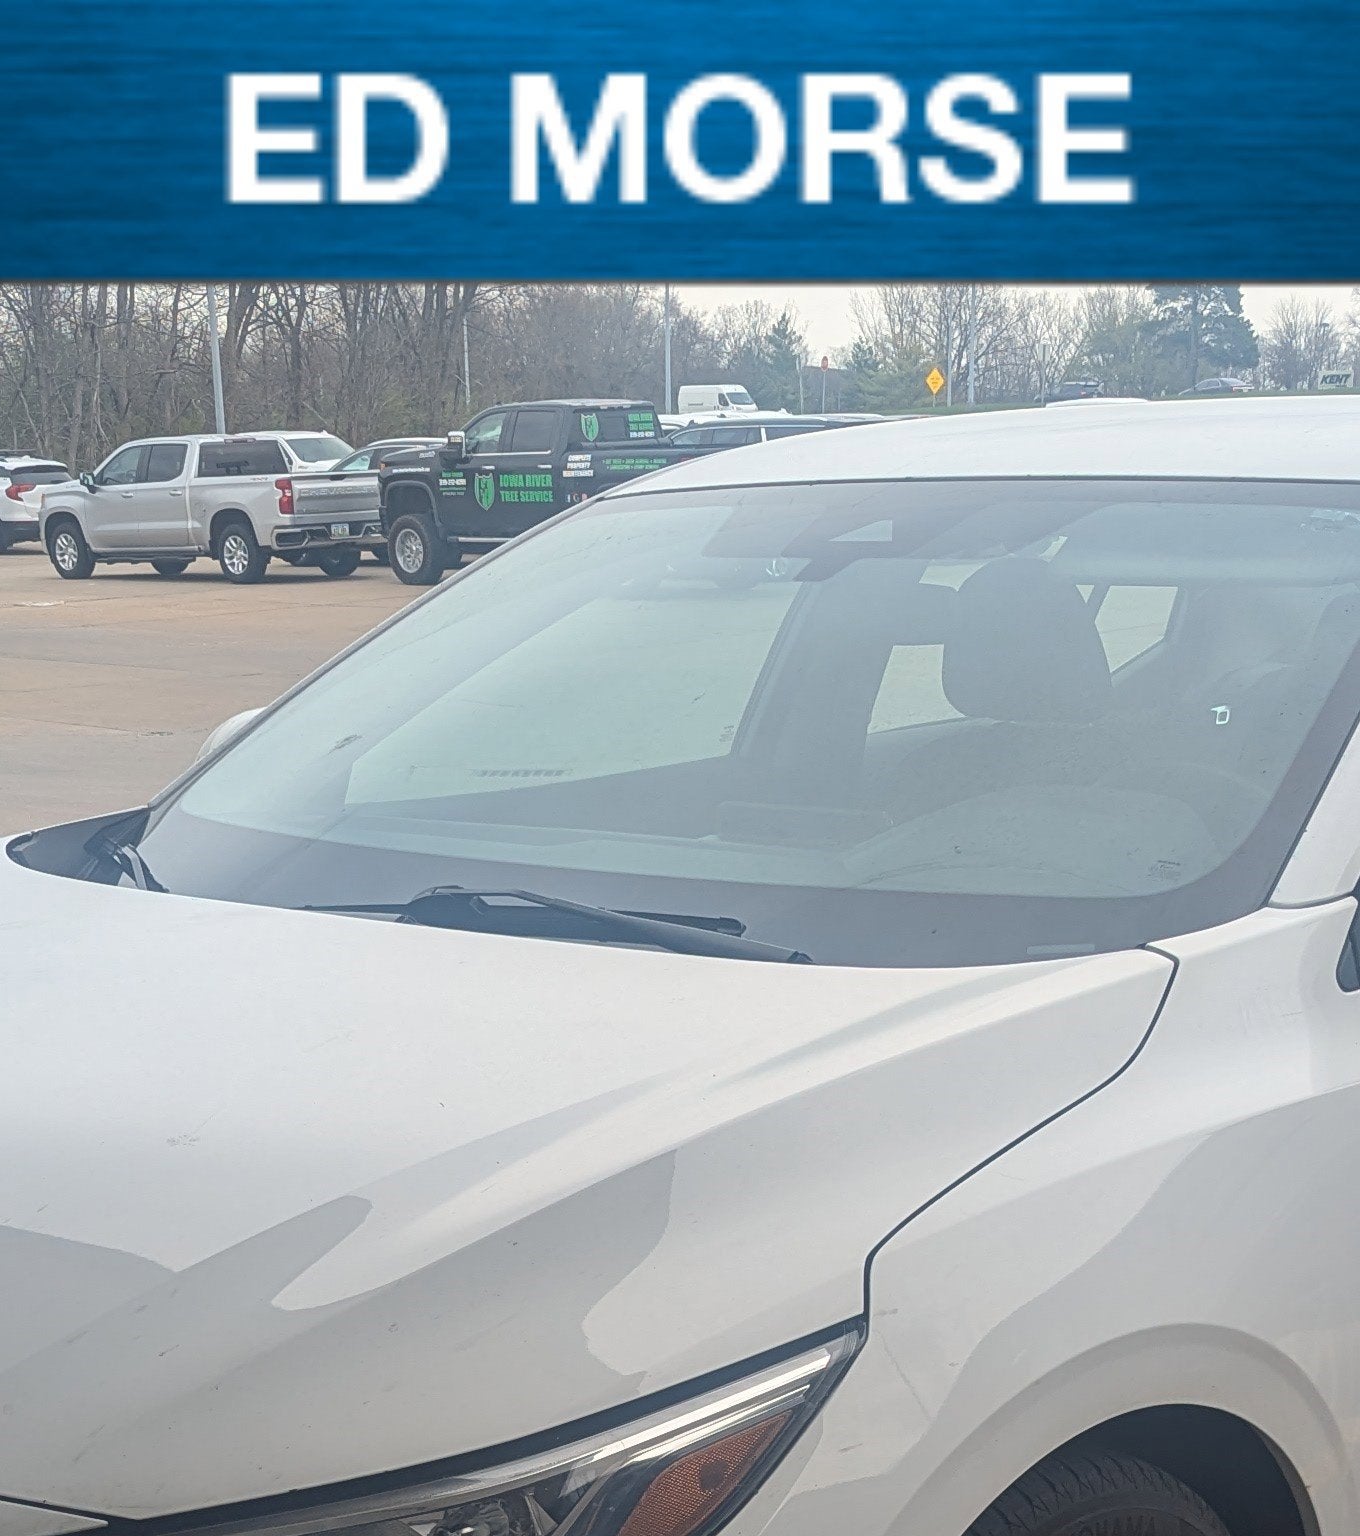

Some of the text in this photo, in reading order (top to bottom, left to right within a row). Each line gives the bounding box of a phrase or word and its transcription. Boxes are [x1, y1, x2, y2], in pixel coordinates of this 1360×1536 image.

[1320, 373, 1351, 385] KENT
[499, 474, 553, 487] IOWA RIVER
[499, 490, 519, 502] TREE
[520, 490, 554, 503] SERVICE
